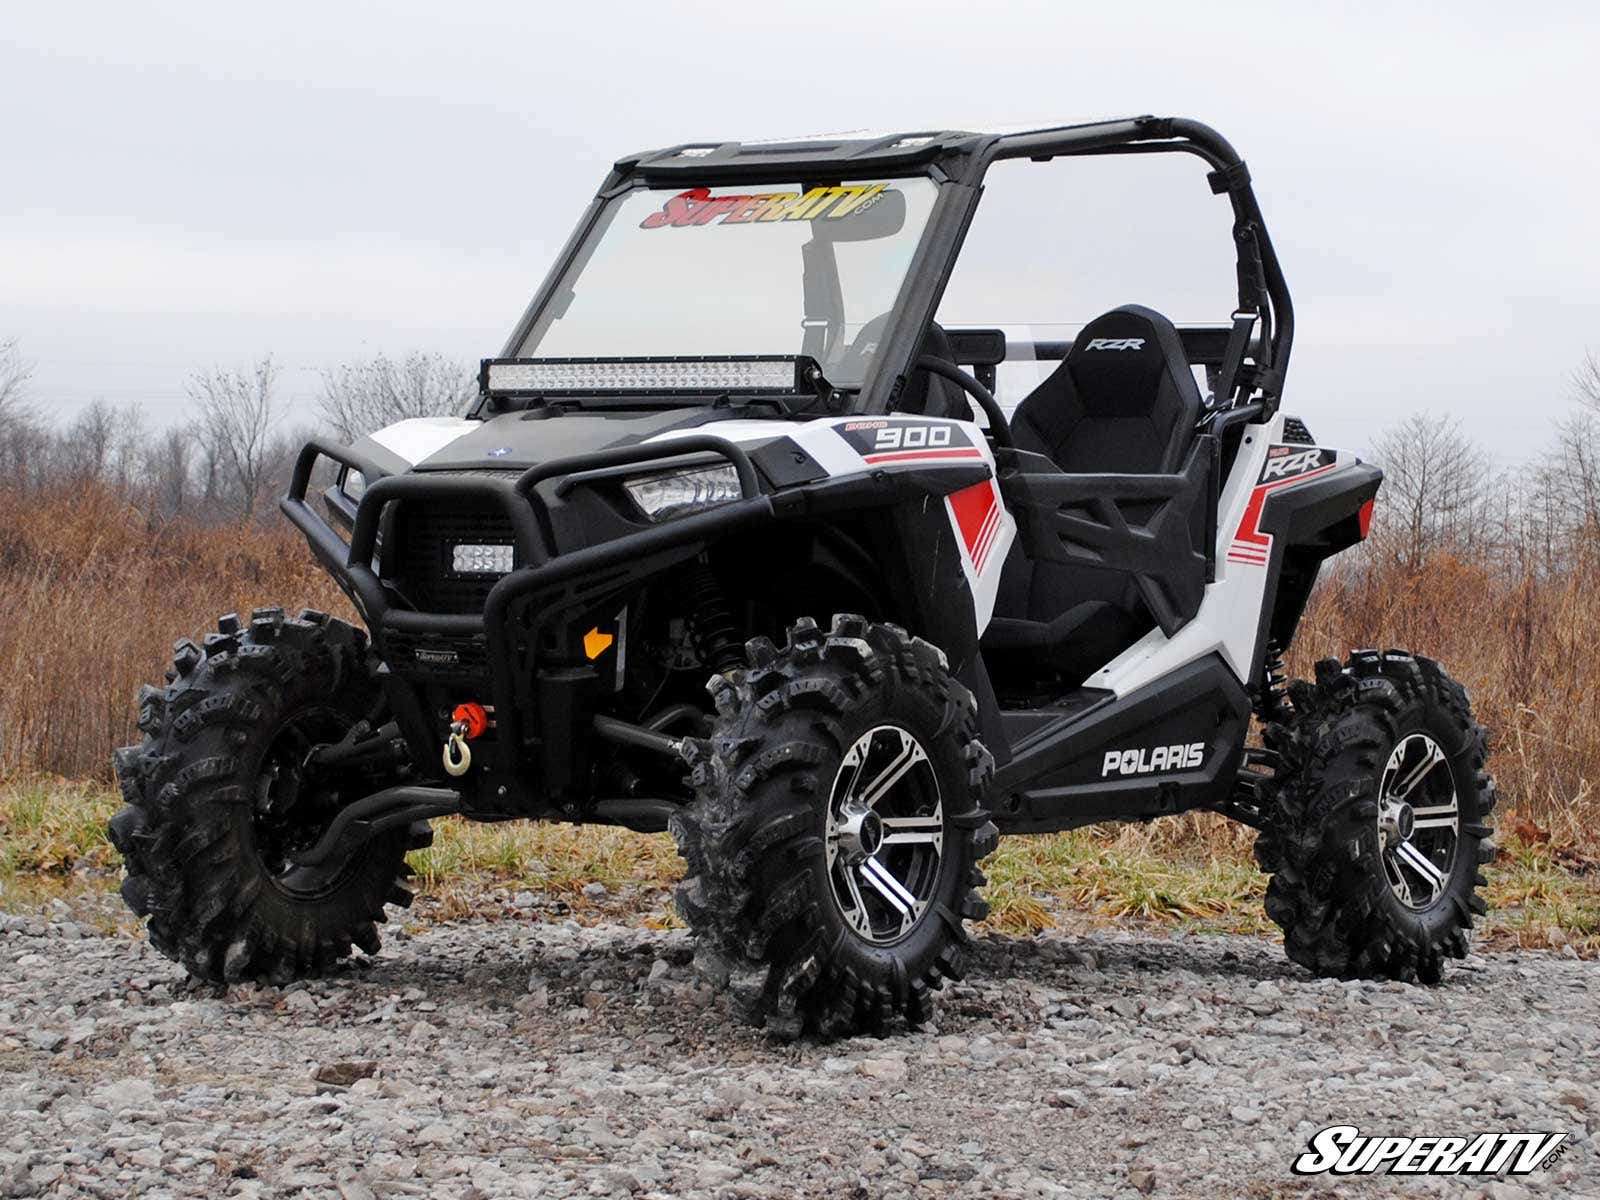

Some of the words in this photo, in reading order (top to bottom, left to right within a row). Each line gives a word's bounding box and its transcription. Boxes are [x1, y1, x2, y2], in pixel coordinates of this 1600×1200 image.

[1084, 338, 1146, 352] RZR
[874, 425, 952, 450] 900
[1262, 449, 1322, 481] RZR
[1101, 742, 1205, 777] POLARIS
